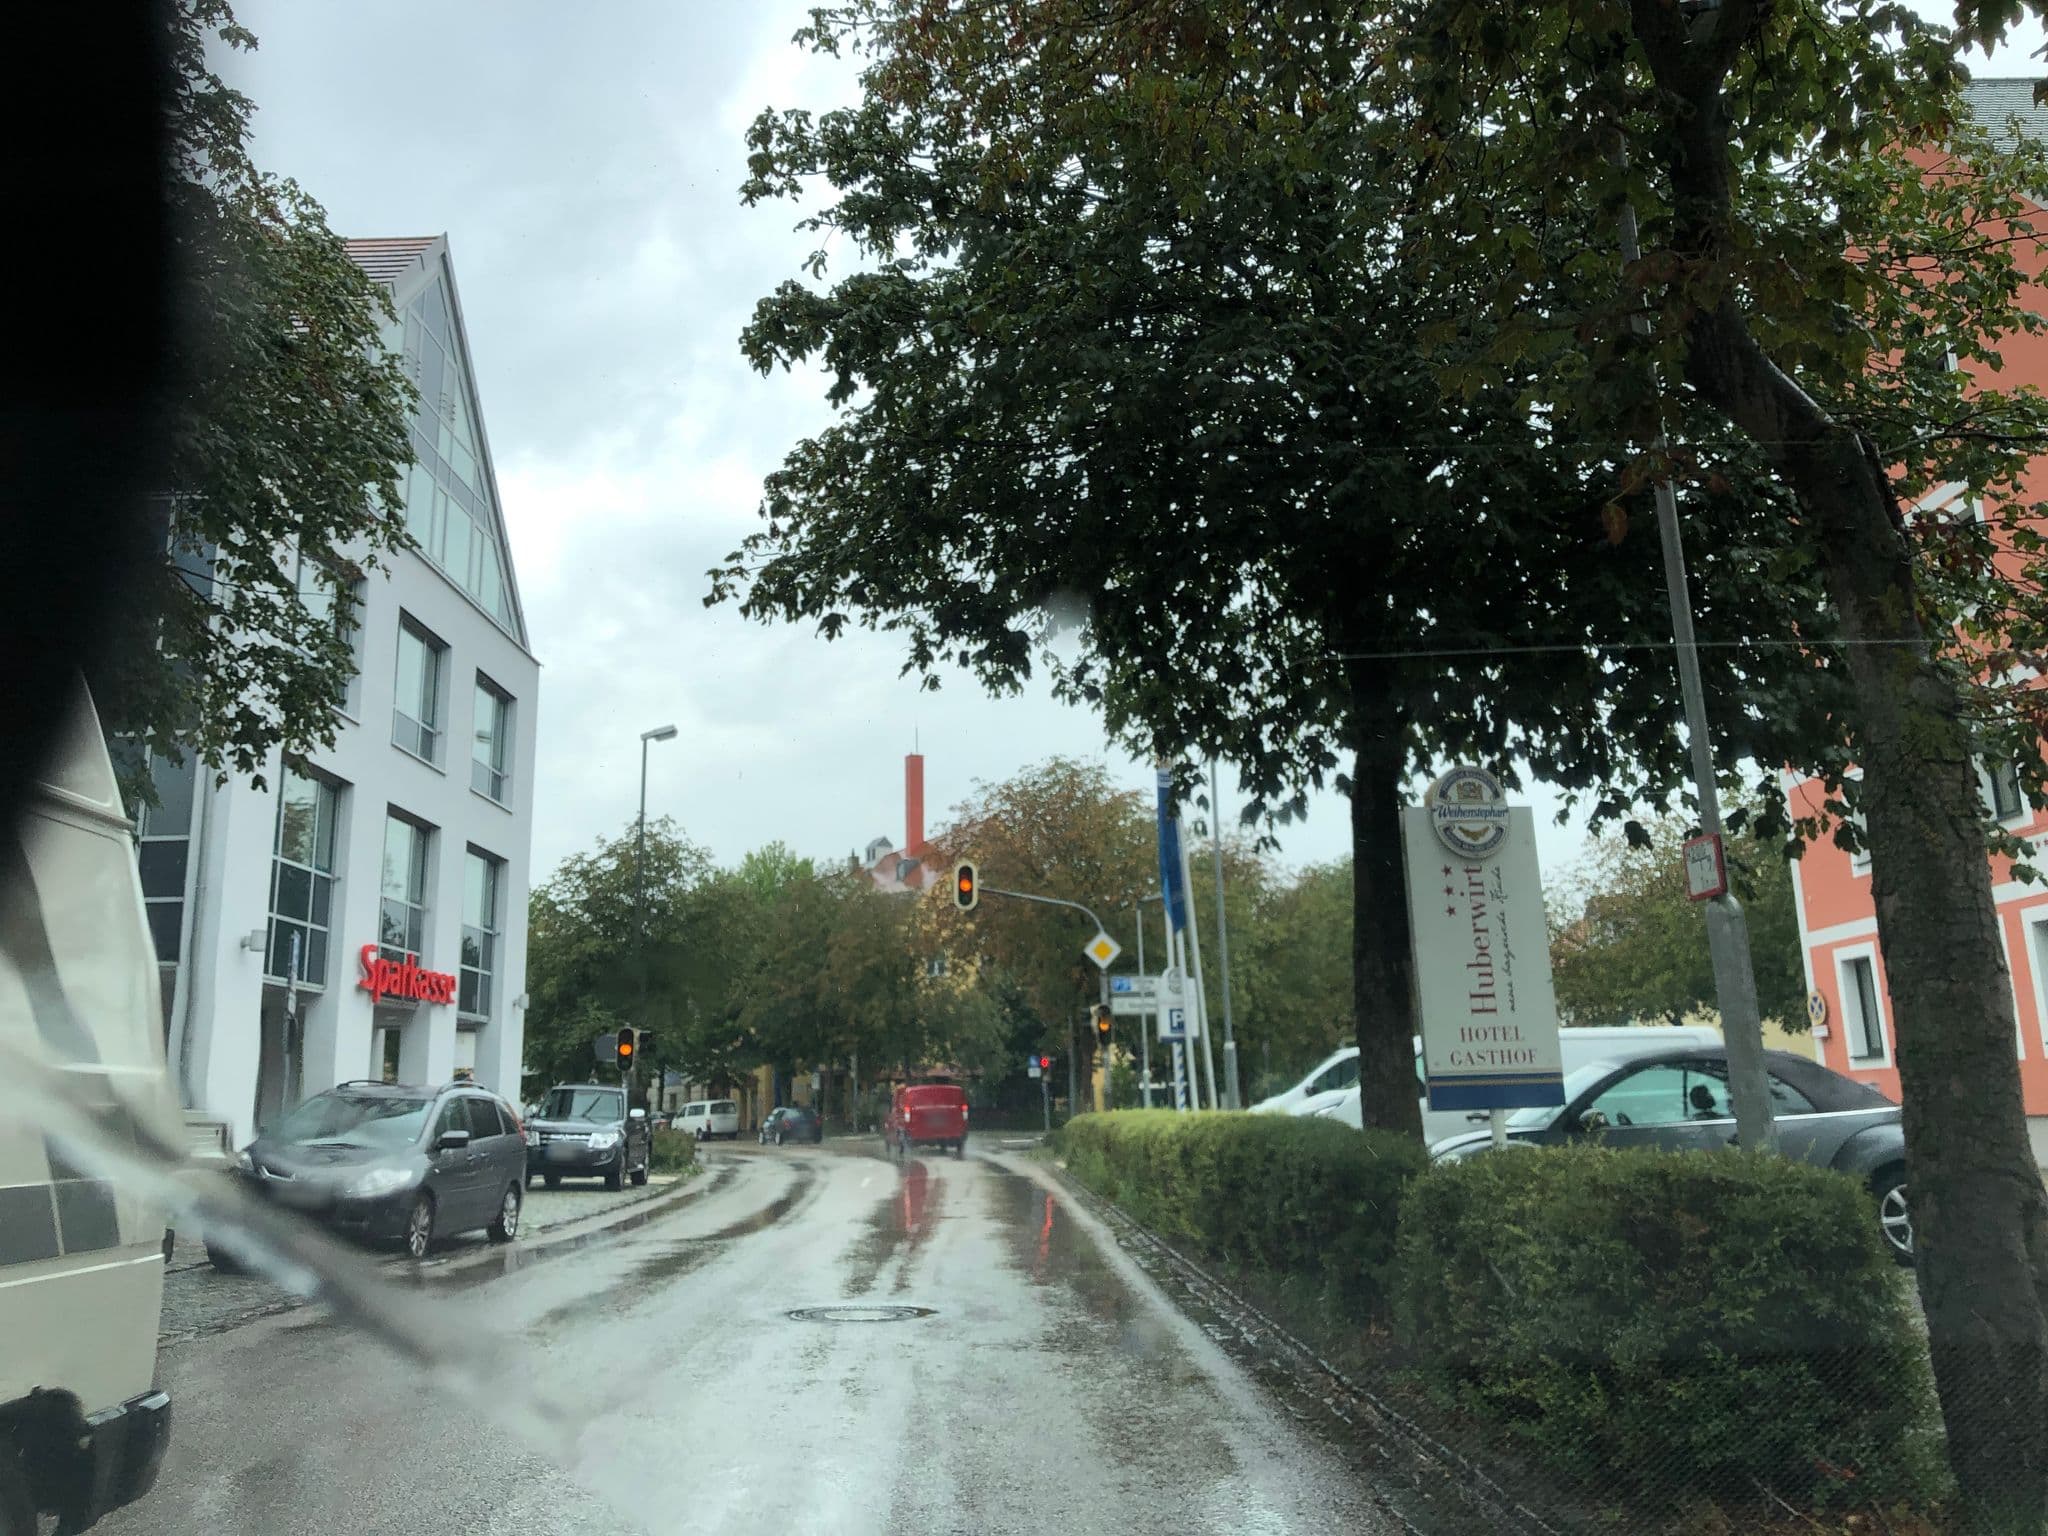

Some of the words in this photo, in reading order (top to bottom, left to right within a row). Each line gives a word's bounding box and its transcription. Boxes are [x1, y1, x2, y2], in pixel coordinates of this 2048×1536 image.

[1434, 804, 1508, 820] Weihenstephan
[1460, 865, 1498, 1016] Huberwirt
[358, 944, 456, 1004] Sparkasse
[1460, 1025, 1525, 1042] HOTEL
[1450, 1048, 1537, 1066] GASTHOF
